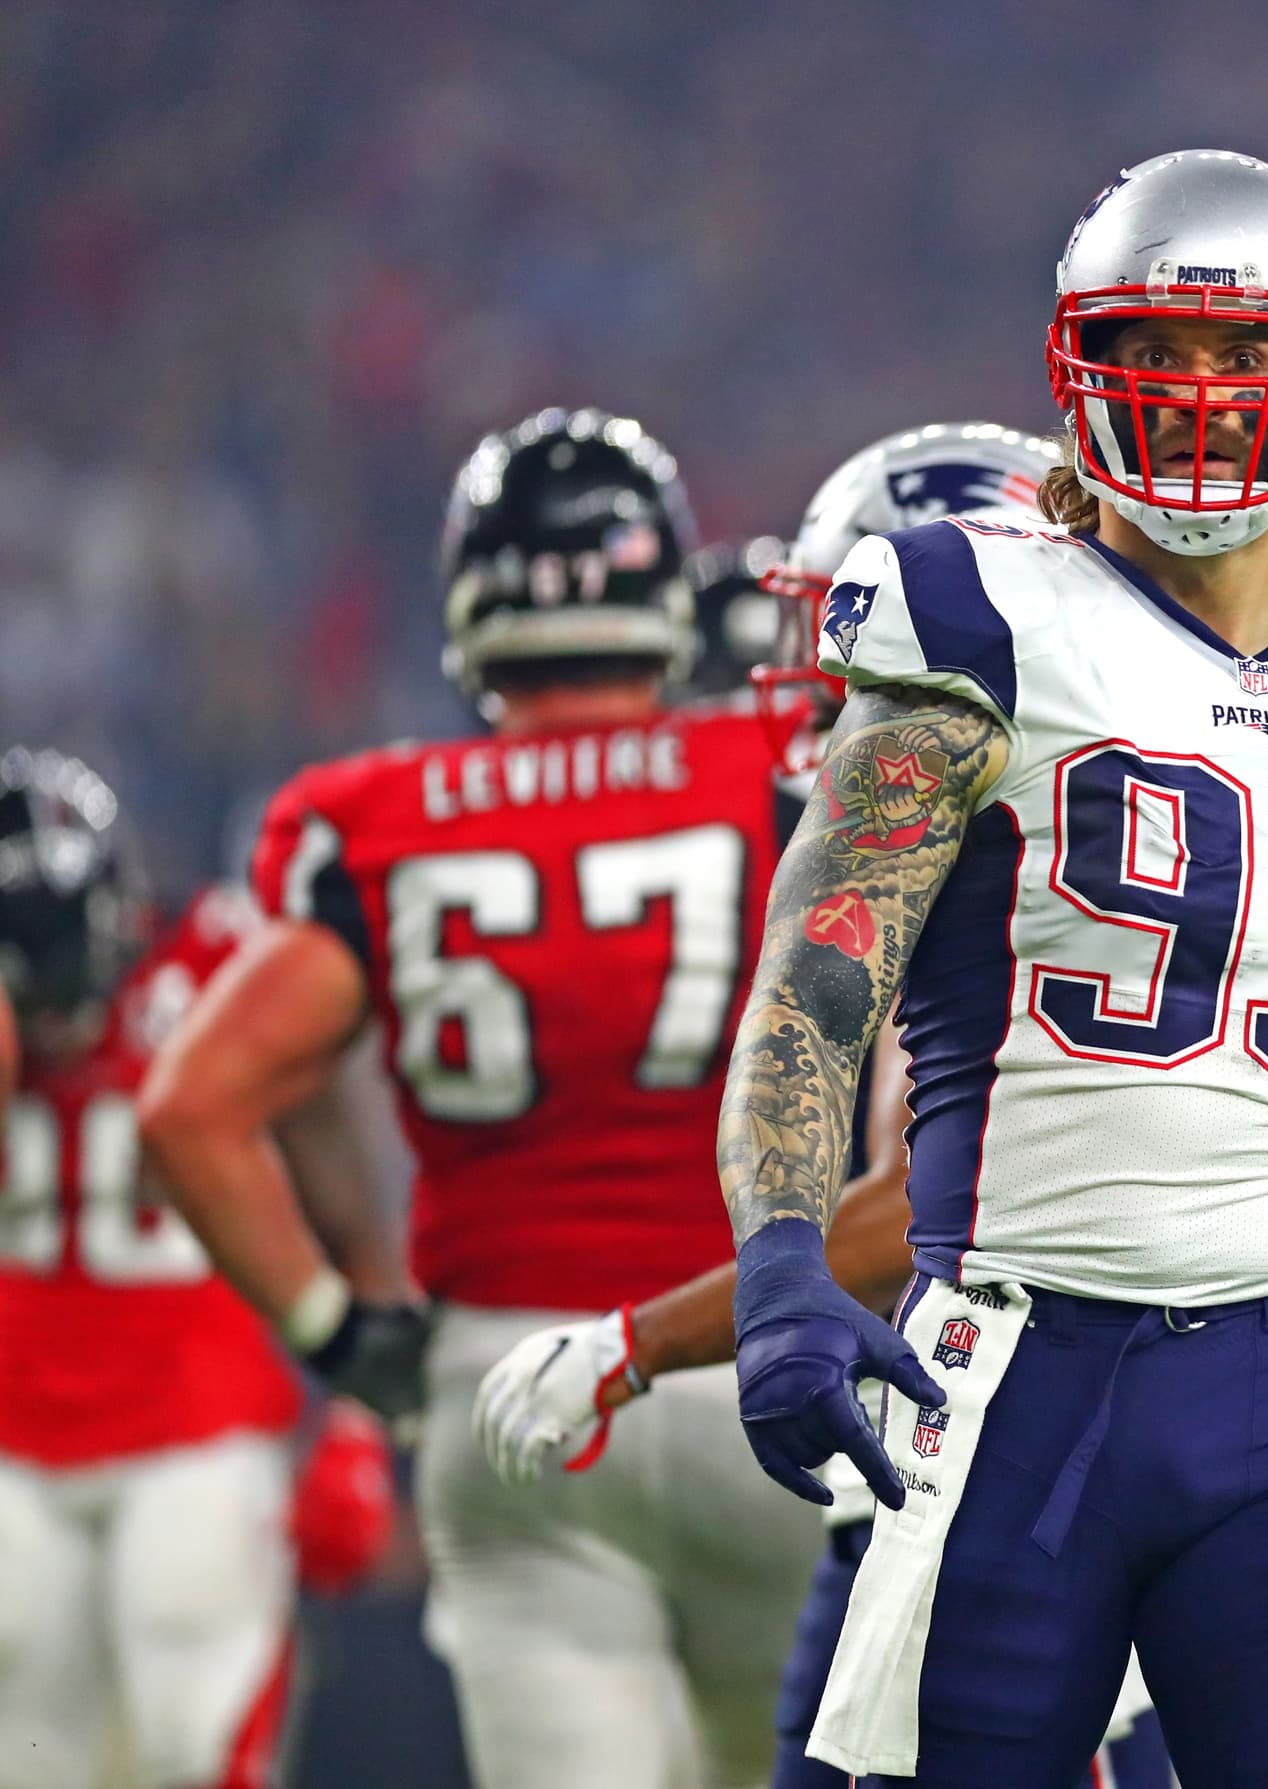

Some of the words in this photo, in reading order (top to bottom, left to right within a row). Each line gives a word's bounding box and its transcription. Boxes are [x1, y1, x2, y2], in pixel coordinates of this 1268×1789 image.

[1177, 265, 1237, 287] PATRIOTS
[1242, 672, 1268, 693] NFL
[387, 822, 746, 1123] 67
[944, 1321, 978, 1352] NFL
[913, 1425, 941, 1455] NFL
